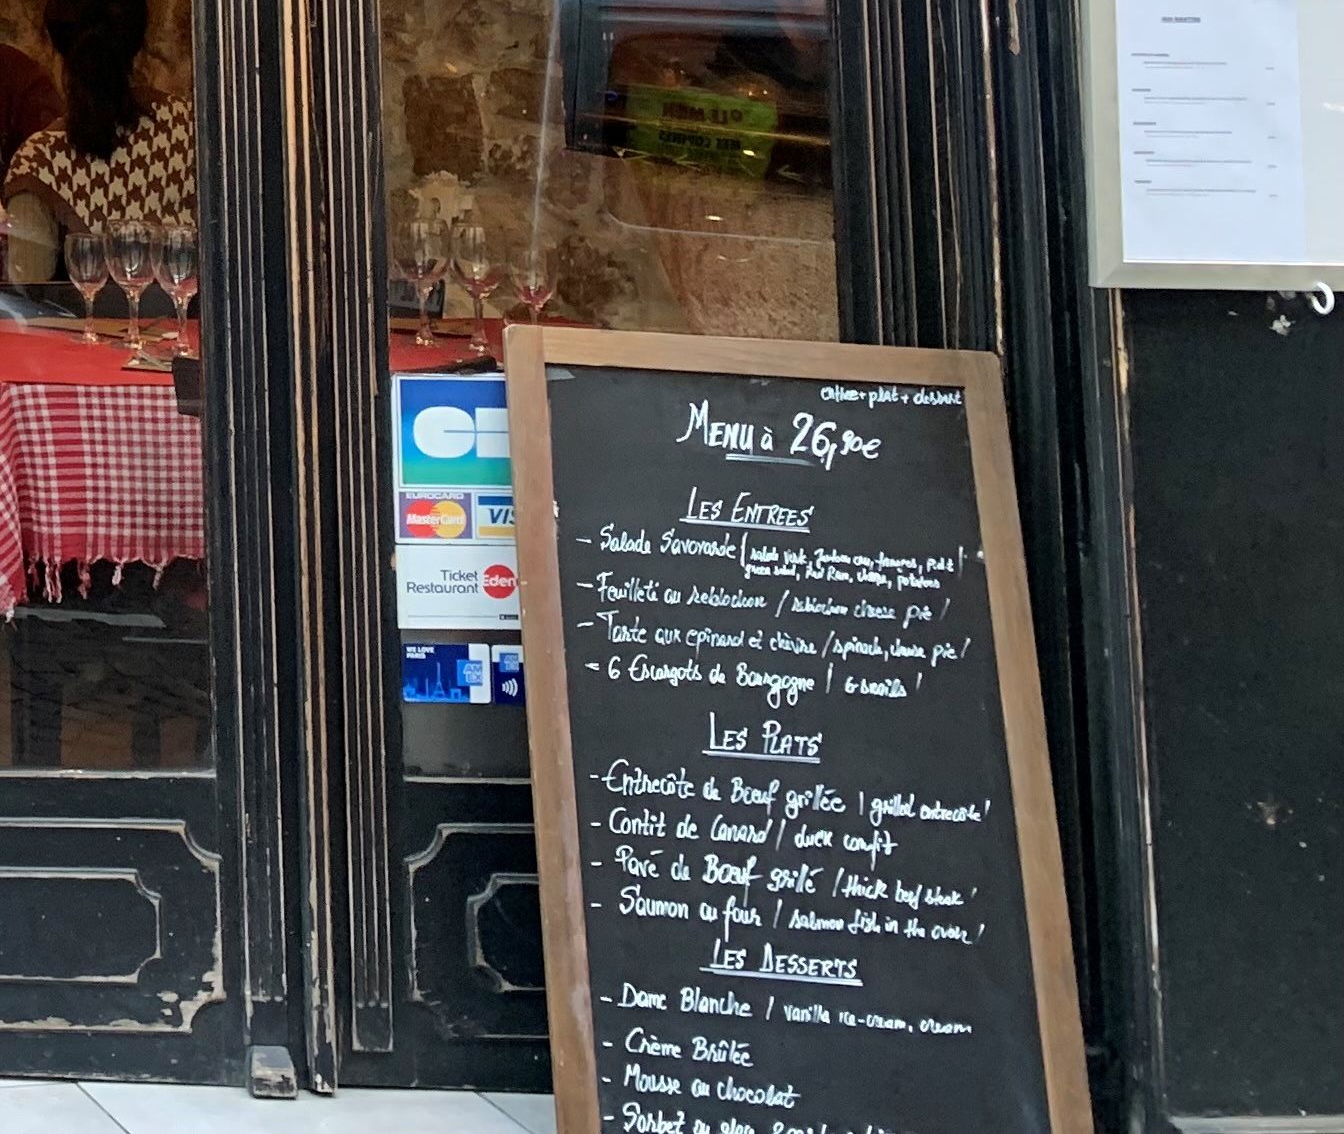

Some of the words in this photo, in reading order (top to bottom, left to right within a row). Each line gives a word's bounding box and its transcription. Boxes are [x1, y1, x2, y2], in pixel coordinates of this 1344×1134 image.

[676, 400, 753, 450] MENU
[760, 426, 773, 450] à
[406, 513, 466, 525] MasterCard
[686, 487, 723, 520] LES
[731, 492, 814, 525] ENTREES
[407, 582, 478, 593] Restaurant
[440, 570, 478, 581] Ticket
[608, 658, 620, 679] 6
[709, 712, 747, 749] LES
[762, 721, 822, 756] PLATS
[619, 886, 689, 921] Saumon
[711, 939, 746, 968] LES
[760, 943, 857, 978] DESSERTS
[618, 983, 668, 1011] Dame
[680, 988, 752, 1018] Blanche
[624, 1065, 681, 1097] Mousse
